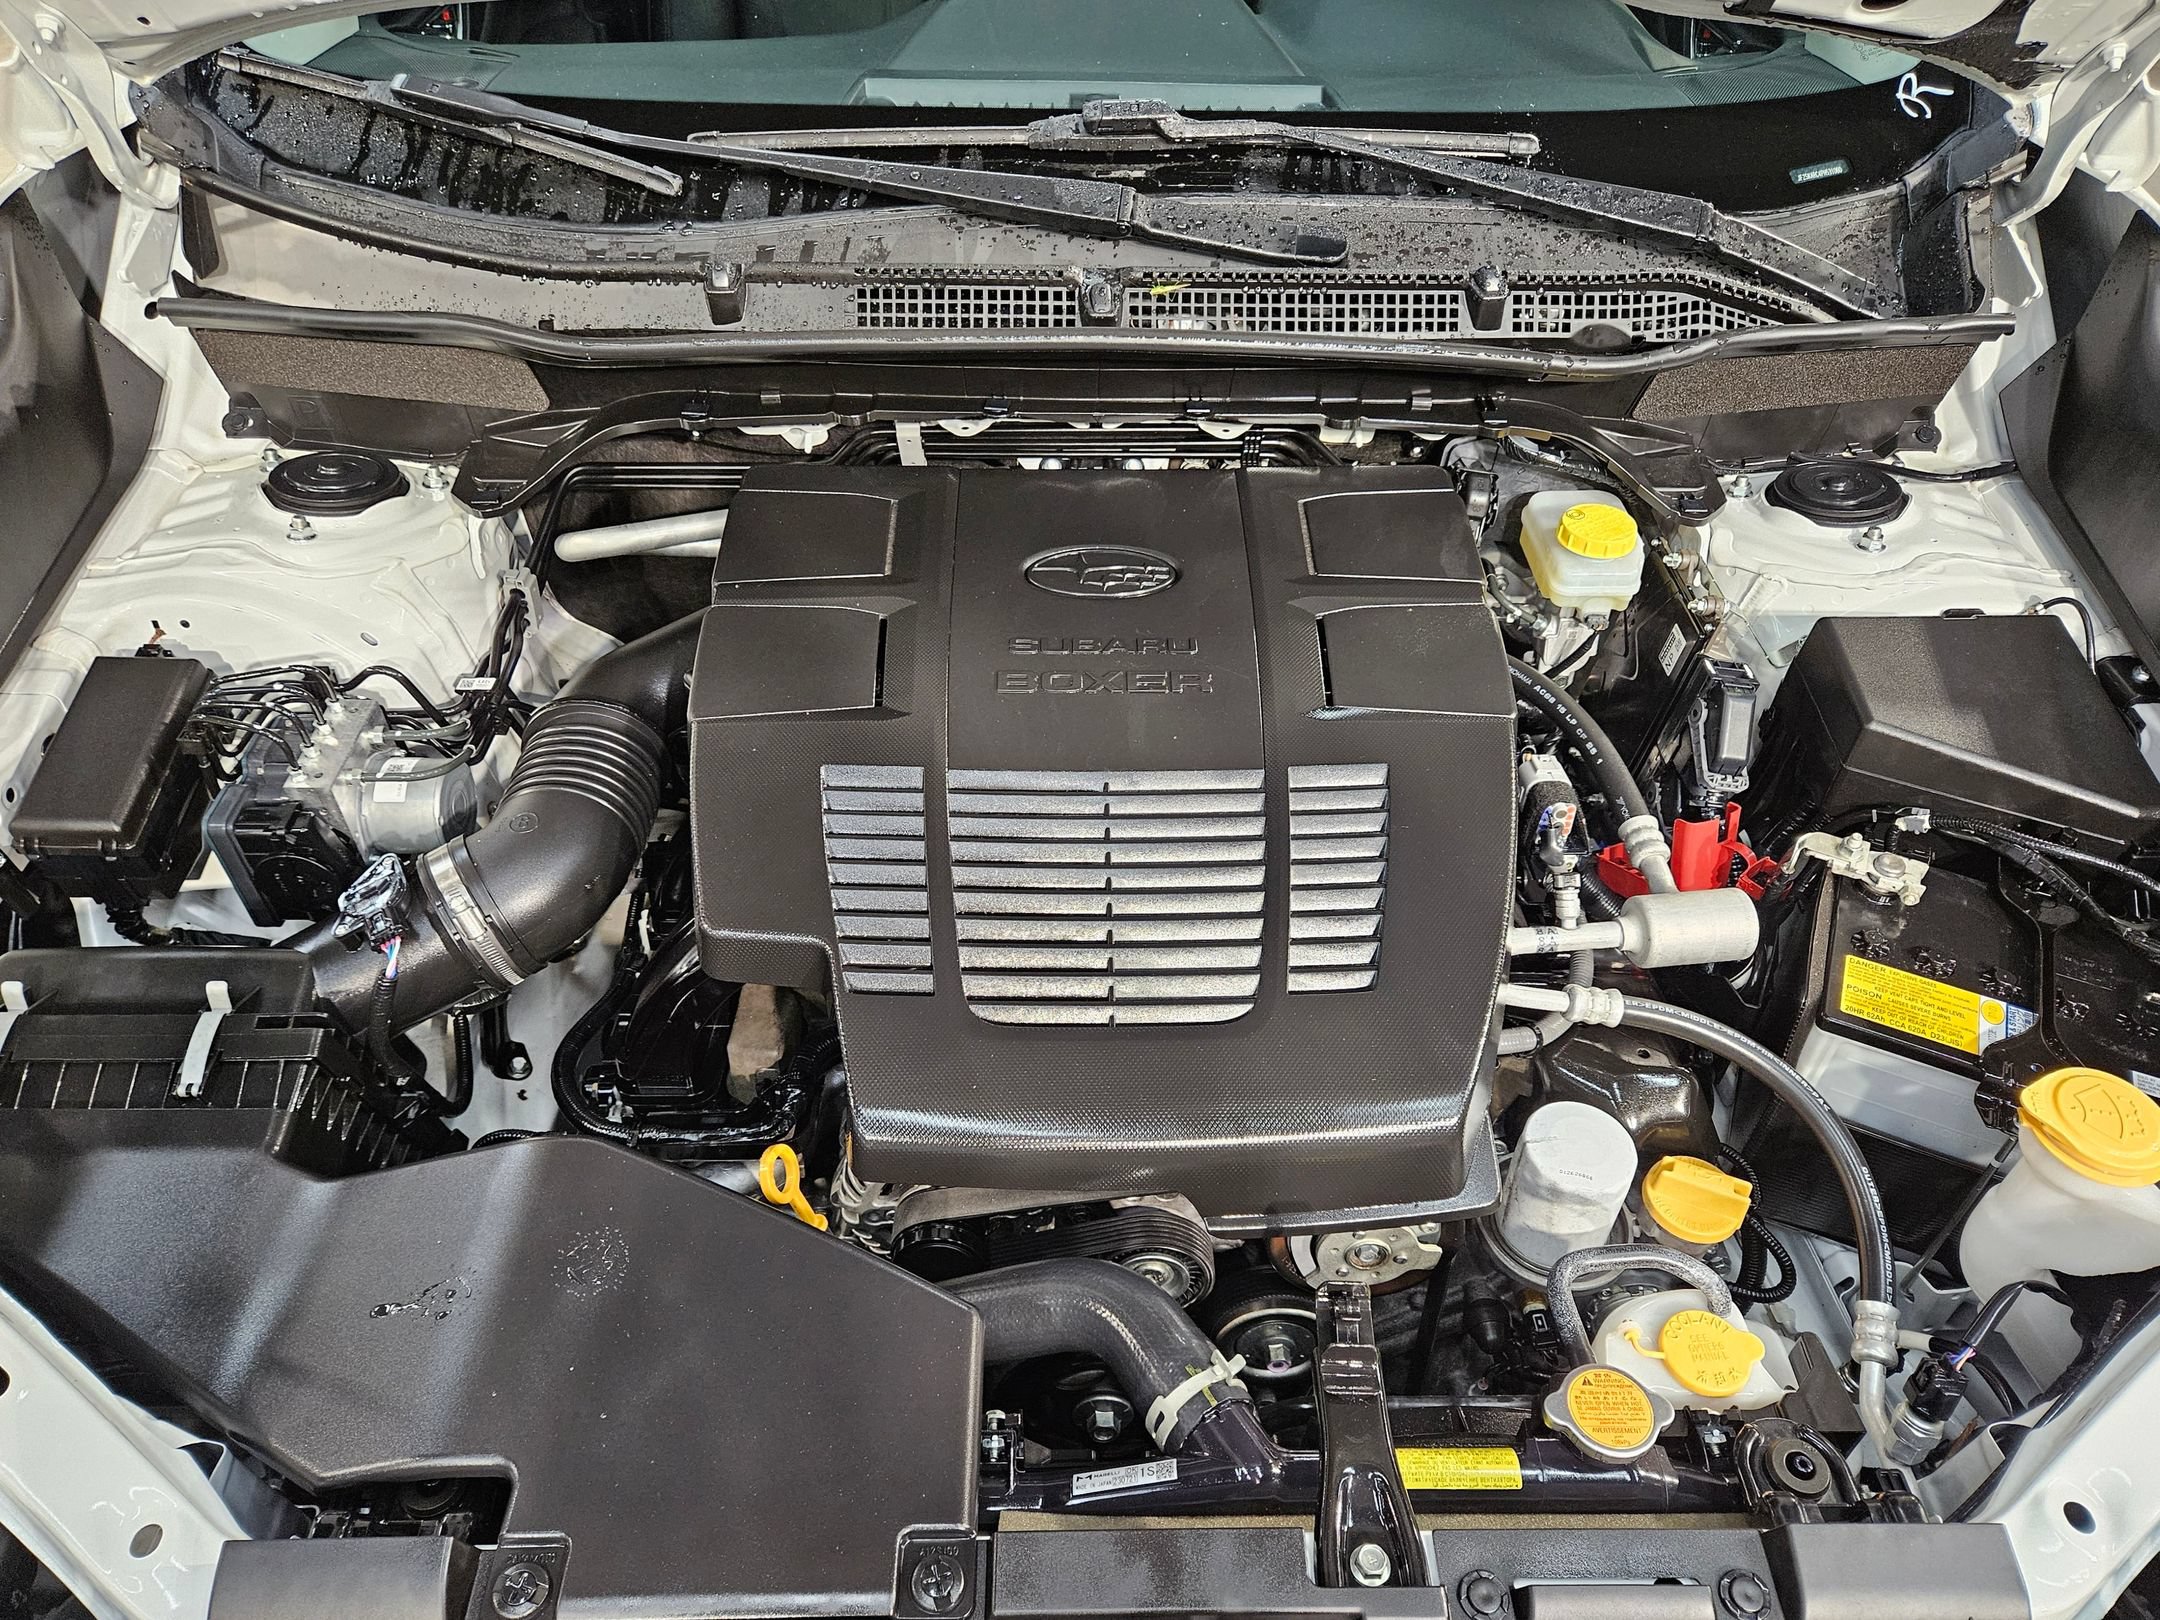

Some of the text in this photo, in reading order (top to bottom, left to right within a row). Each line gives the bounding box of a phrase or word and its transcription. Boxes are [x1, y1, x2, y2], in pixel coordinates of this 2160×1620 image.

[1008, 637, 1200, 655] SUBARU
[996, 670, 1213, 694] BOXER
[1565, 713, 1578, 726] LP
[1849, 957, 1887, 973] DANGER
[1846, 983, 1952, 1022] POISON CAUSES SEVERE BURNS
[1874, 986, 1966, 1019] KEEP VENT CAPS TIGHT AND LEVEL
[1844, 1005, 1865, 1017] 20HR
[1866, 1011, 1886, 1023] 62Ah
[1889, 1018, 1906, 1030] CCA
[1907, 1024, 1927, 1036] 620A
[1871, 1006, 1887, 1016] KEEP
[1886, 1011, 1899, 1019] OUT
[1907, 1017, 1927, 1028] REACH
[1936, 1025, 1964, 1040] CHILDREN
[2008, 1007, 2017, 1027] START
[1664, 1312, 1730, 1339] COOLANT
[1139, 1465, 1155, 1478] 1S
